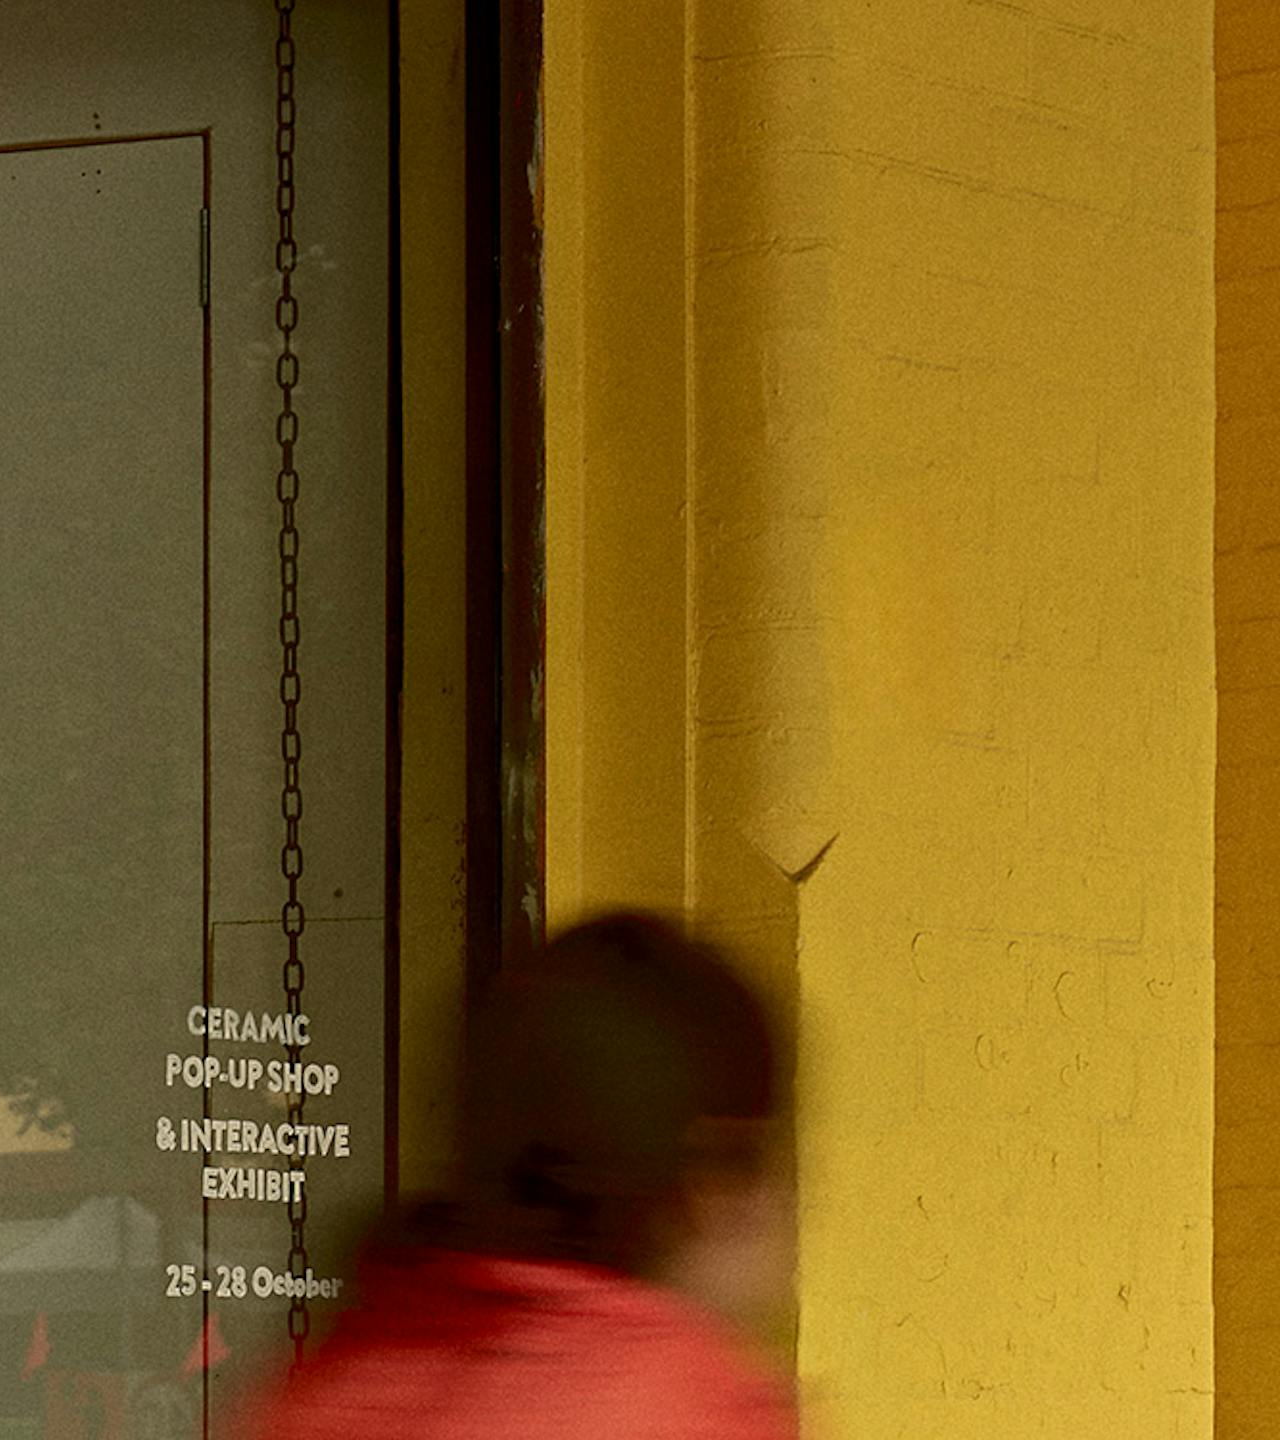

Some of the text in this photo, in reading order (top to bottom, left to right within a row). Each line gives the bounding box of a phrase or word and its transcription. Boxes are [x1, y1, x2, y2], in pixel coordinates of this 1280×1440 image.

[186, 1004, 311, 1046] CERAMIC
[165, 1052, 341, 1096] POP-UP SHOP
[155, 1115, 350, 1158] & INTERACTIVE
[201, 1166, 306, 1203] EXHIBIT
[165, 1264, 197, 1298] 25
[216, 1264, 247, 1299] 28
[251, 1265, 343, 1300] October
